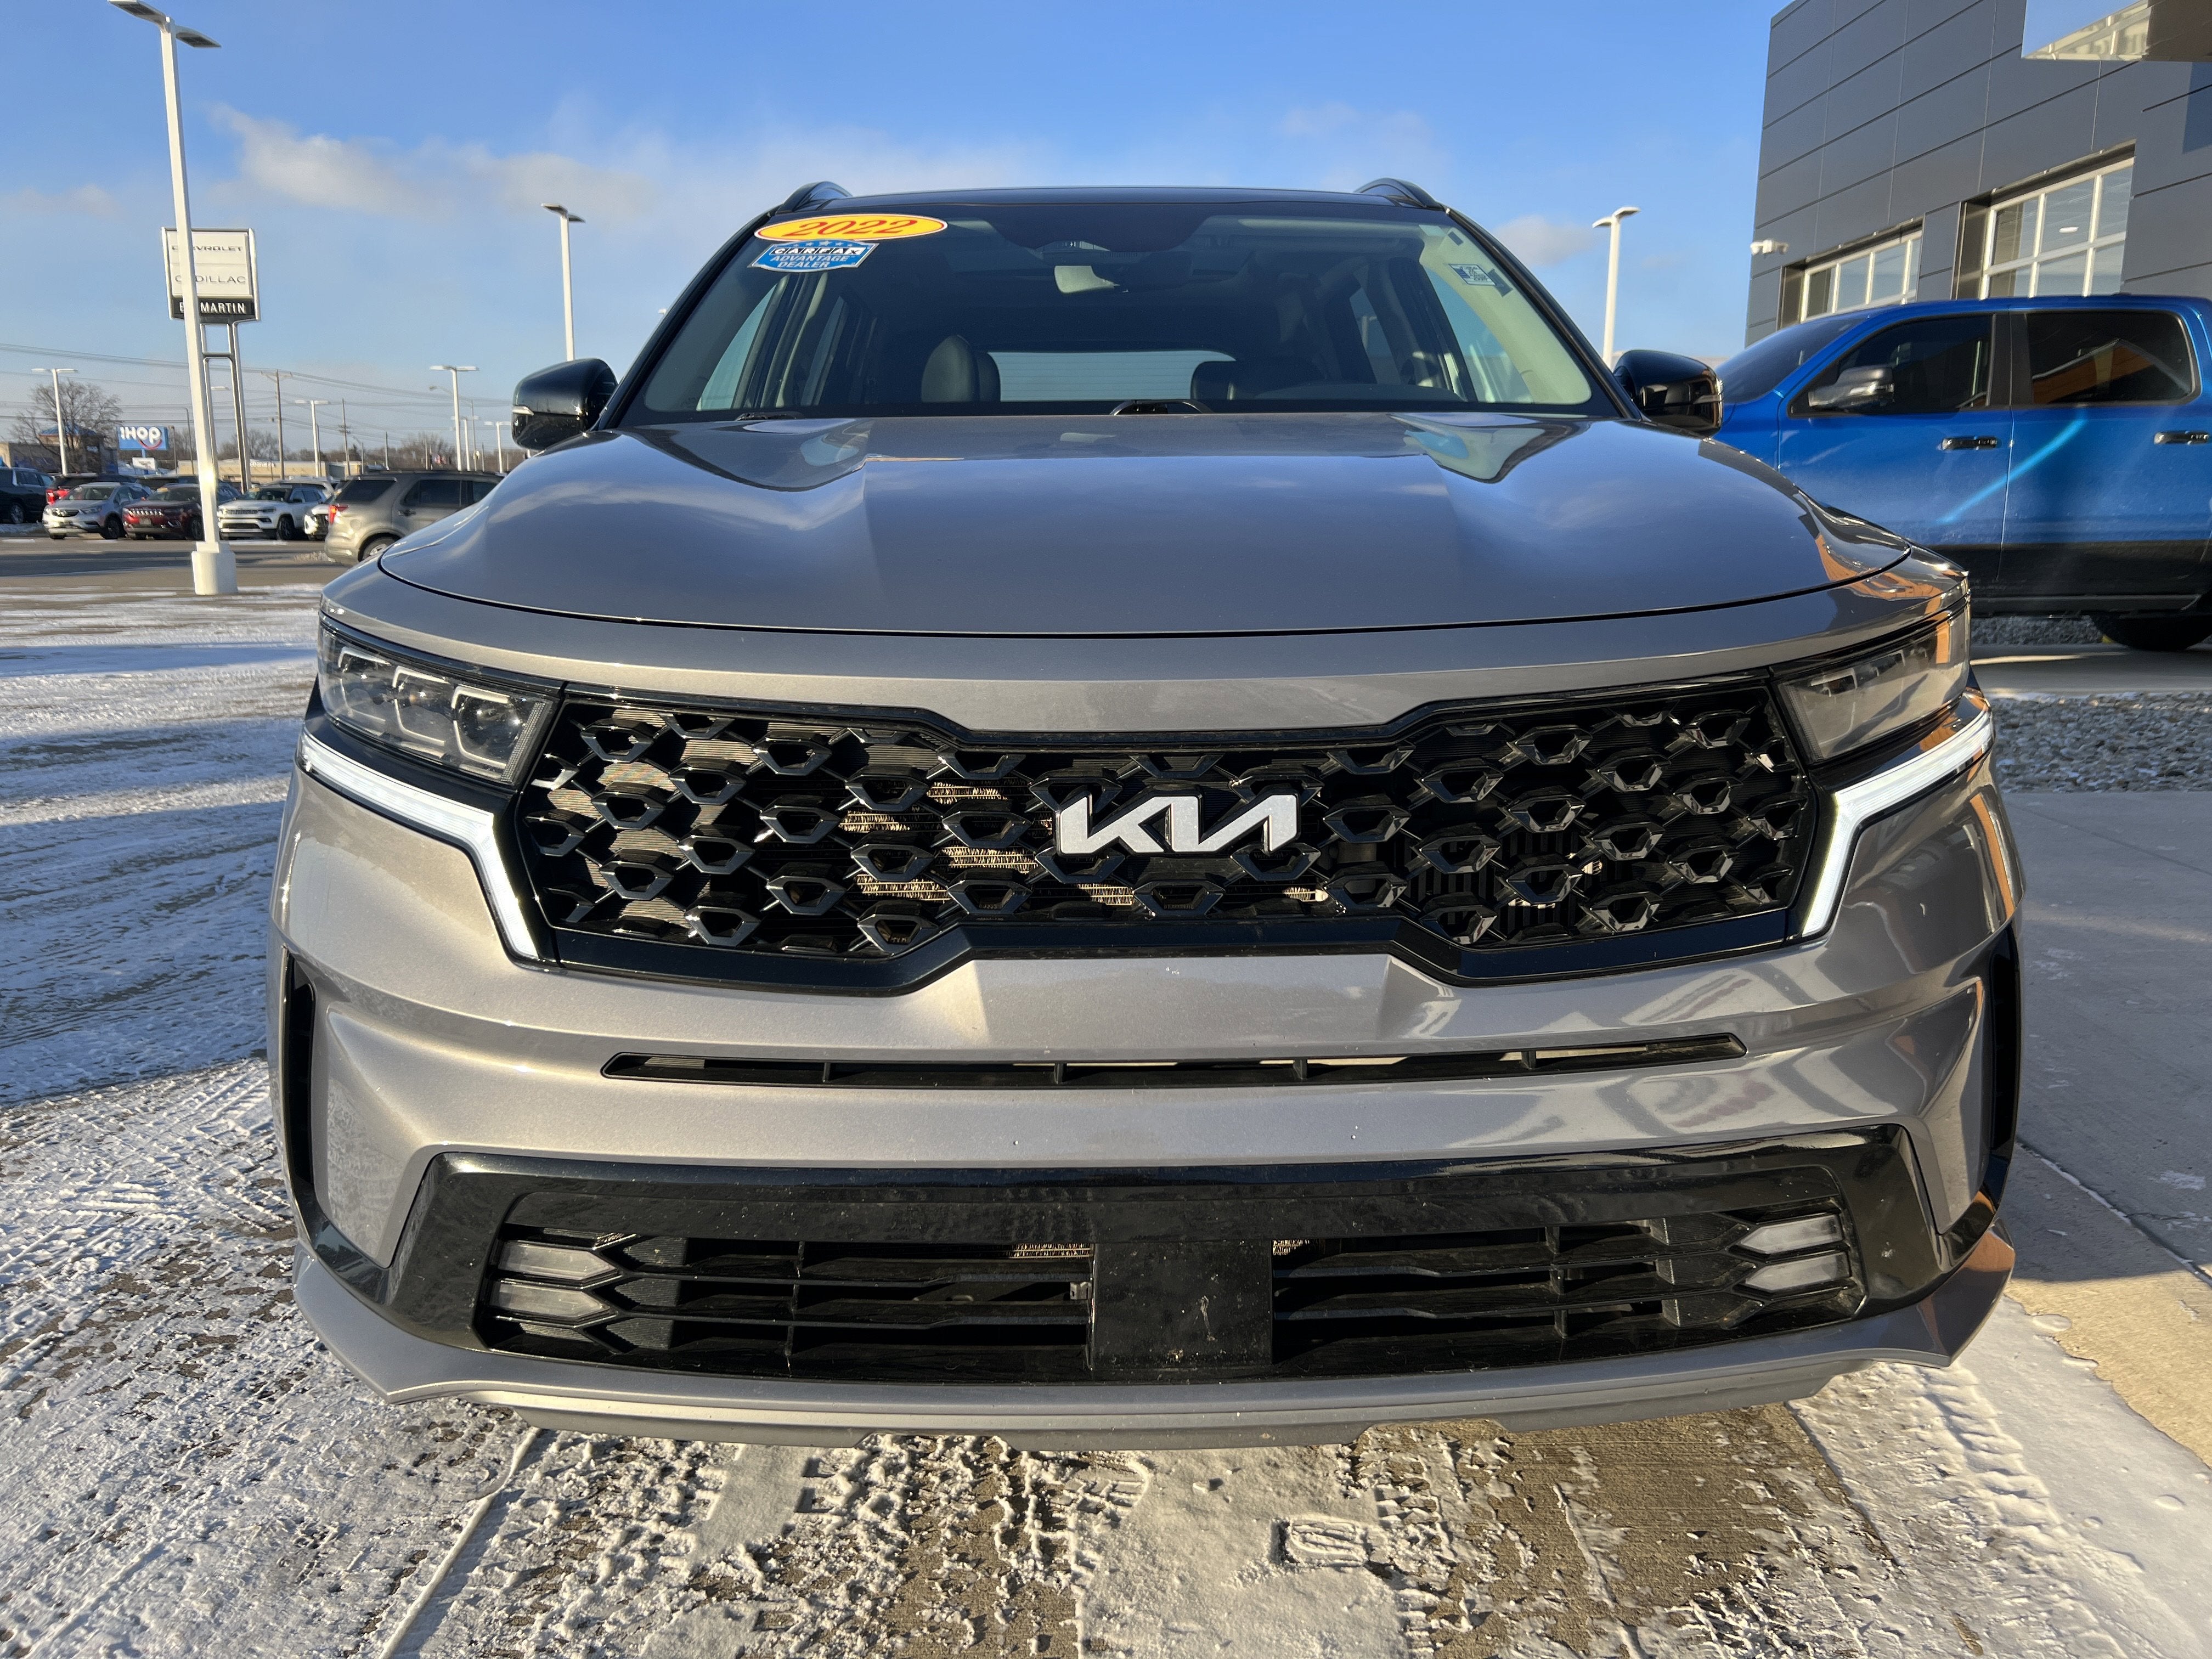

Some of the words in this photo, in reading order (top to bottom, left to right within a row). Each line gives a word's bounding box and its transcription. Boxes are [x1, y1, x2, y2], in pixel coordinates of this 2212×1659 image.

[782, 219, 918, 237] 2022
[774, 247, 865, 255] CARFAX
[175, 275, 246, 283] CDILLAC
[200, 302, 246, 314] MARTIN
[1060, 794, 1297, 854] KIA
